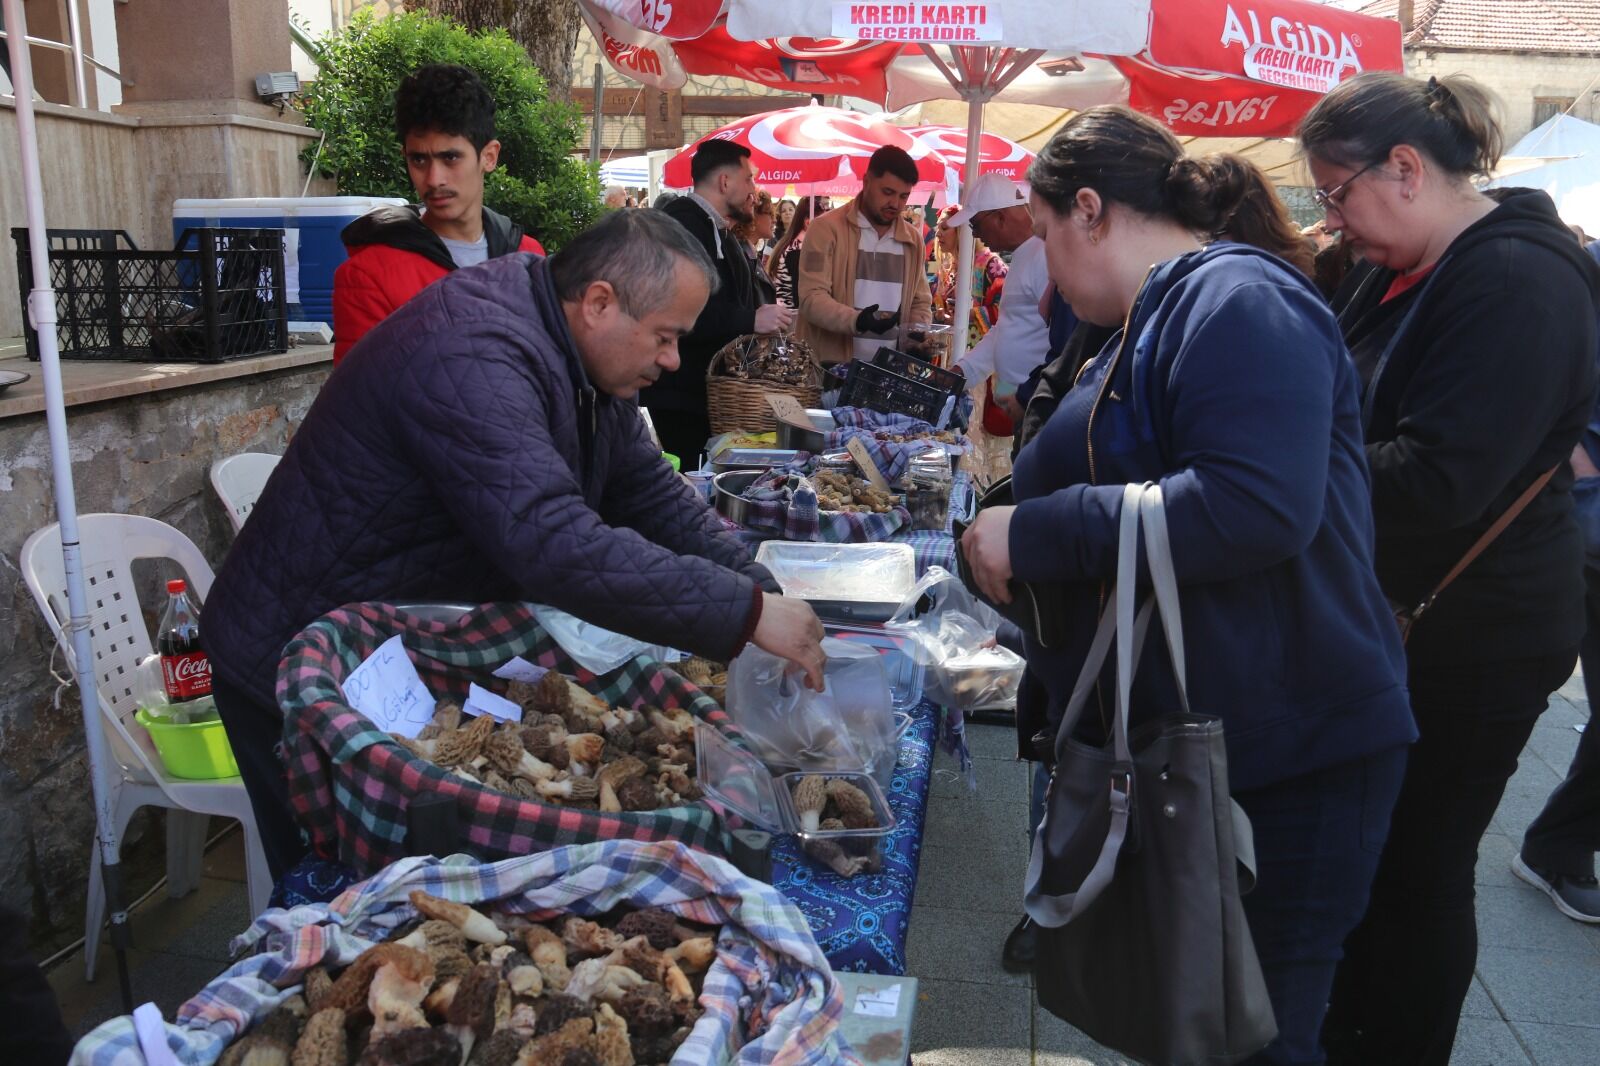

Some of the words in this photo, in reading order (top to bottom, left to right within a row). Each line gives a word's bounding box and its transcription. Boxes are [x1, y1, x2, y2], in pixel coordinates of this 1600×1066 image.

[850, 2, 915, 25] KREDİ
[921, 5, 987, 25] KARTI
[1253, 47, 1296, 71] KREDİ
[1296, 54, 1335, 79] KARTI
